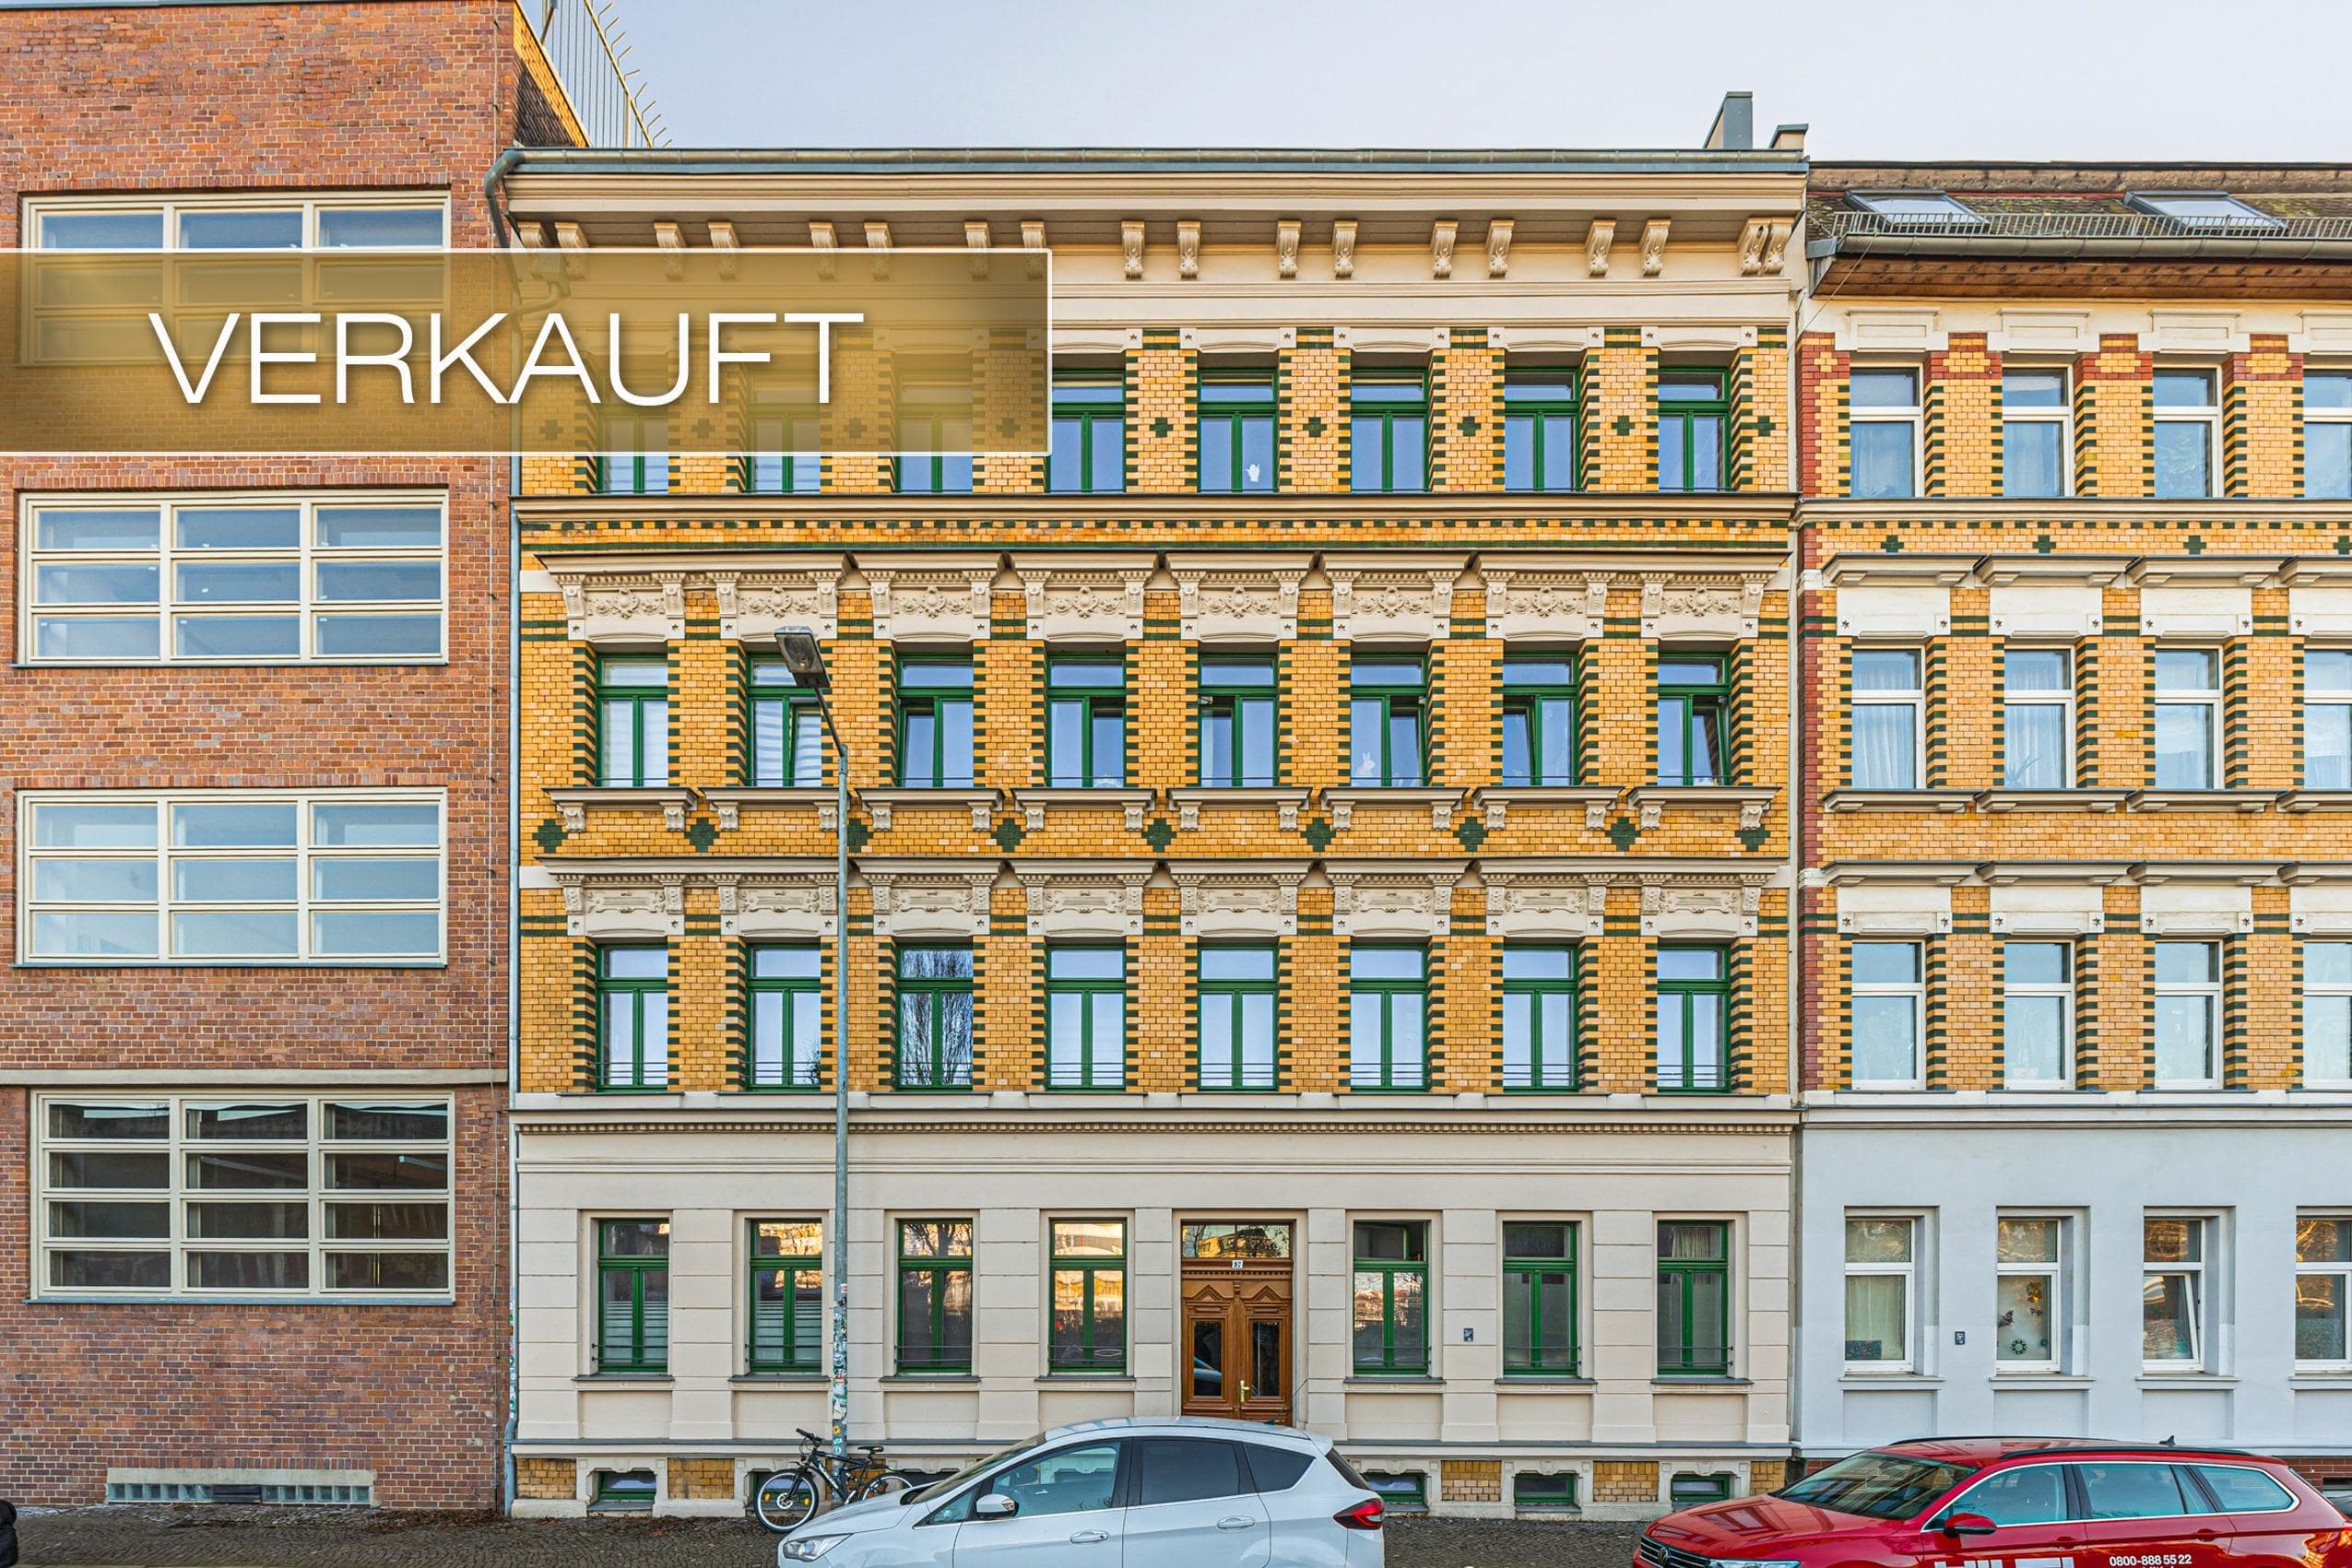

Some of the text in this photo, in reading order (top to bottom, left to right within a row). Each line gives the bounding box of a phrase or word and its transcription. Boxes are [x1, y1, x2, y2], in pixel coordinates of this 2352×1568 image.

[2110, 1554, 2192, 1566] 0800-888 55 22
